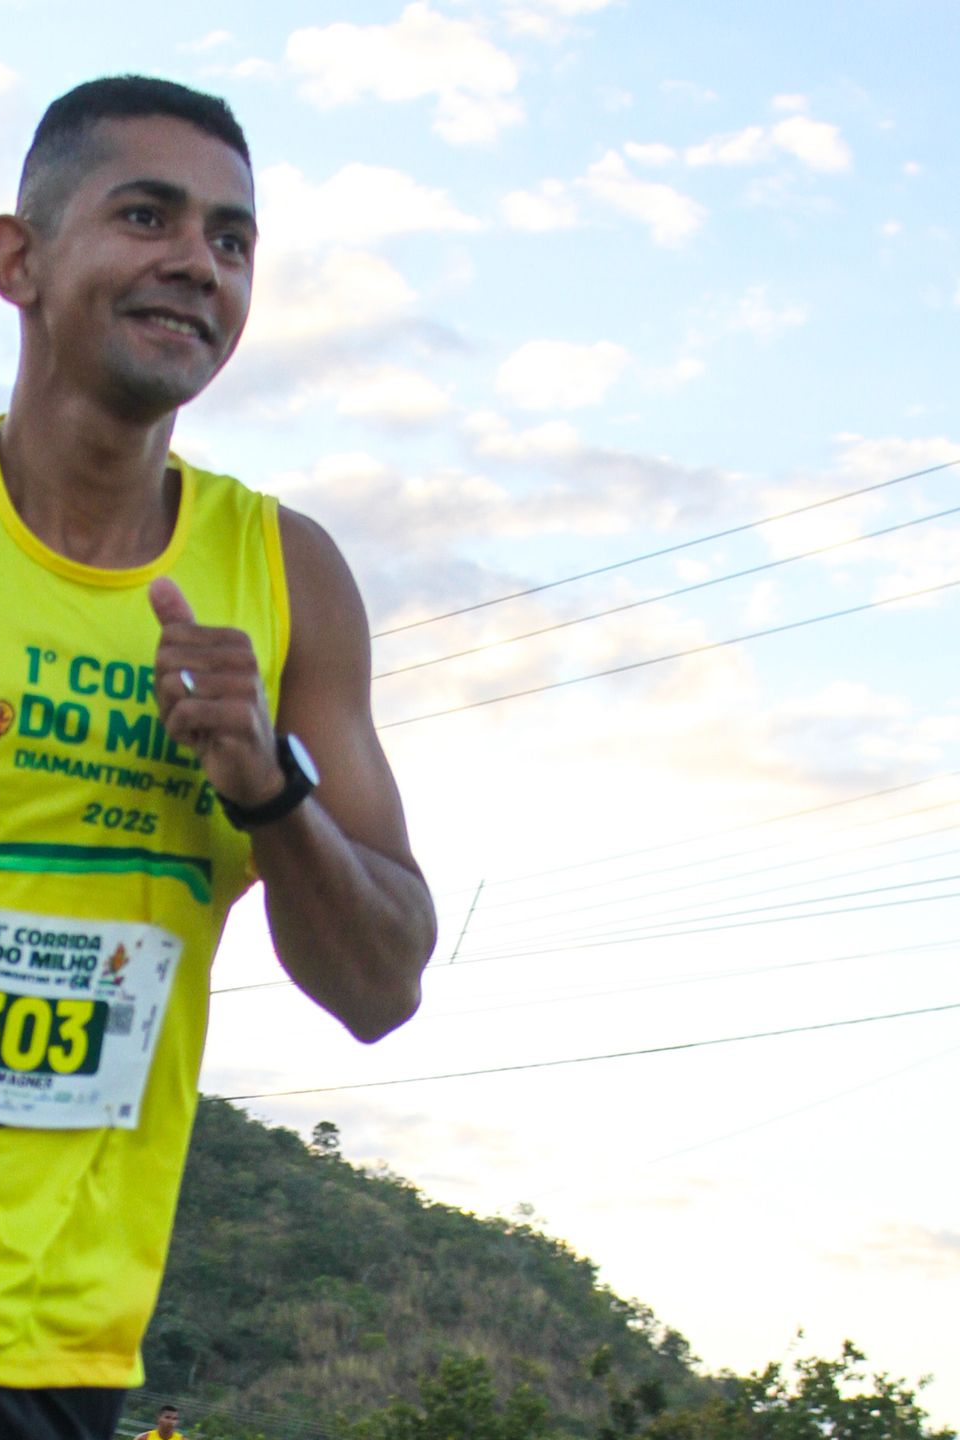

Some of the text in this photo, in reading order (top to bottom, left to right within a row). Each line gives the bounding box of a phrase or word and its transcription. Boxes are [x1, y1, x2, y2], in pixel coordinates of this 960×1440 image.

[69, 655, 156, 704] COR
[18, 693, 201, 769] DO MIL
[82, 802, 159, 835] 2025
[14, 928, 101, 951] CORRIDA
[29, 951, 97, 972] MILHO
